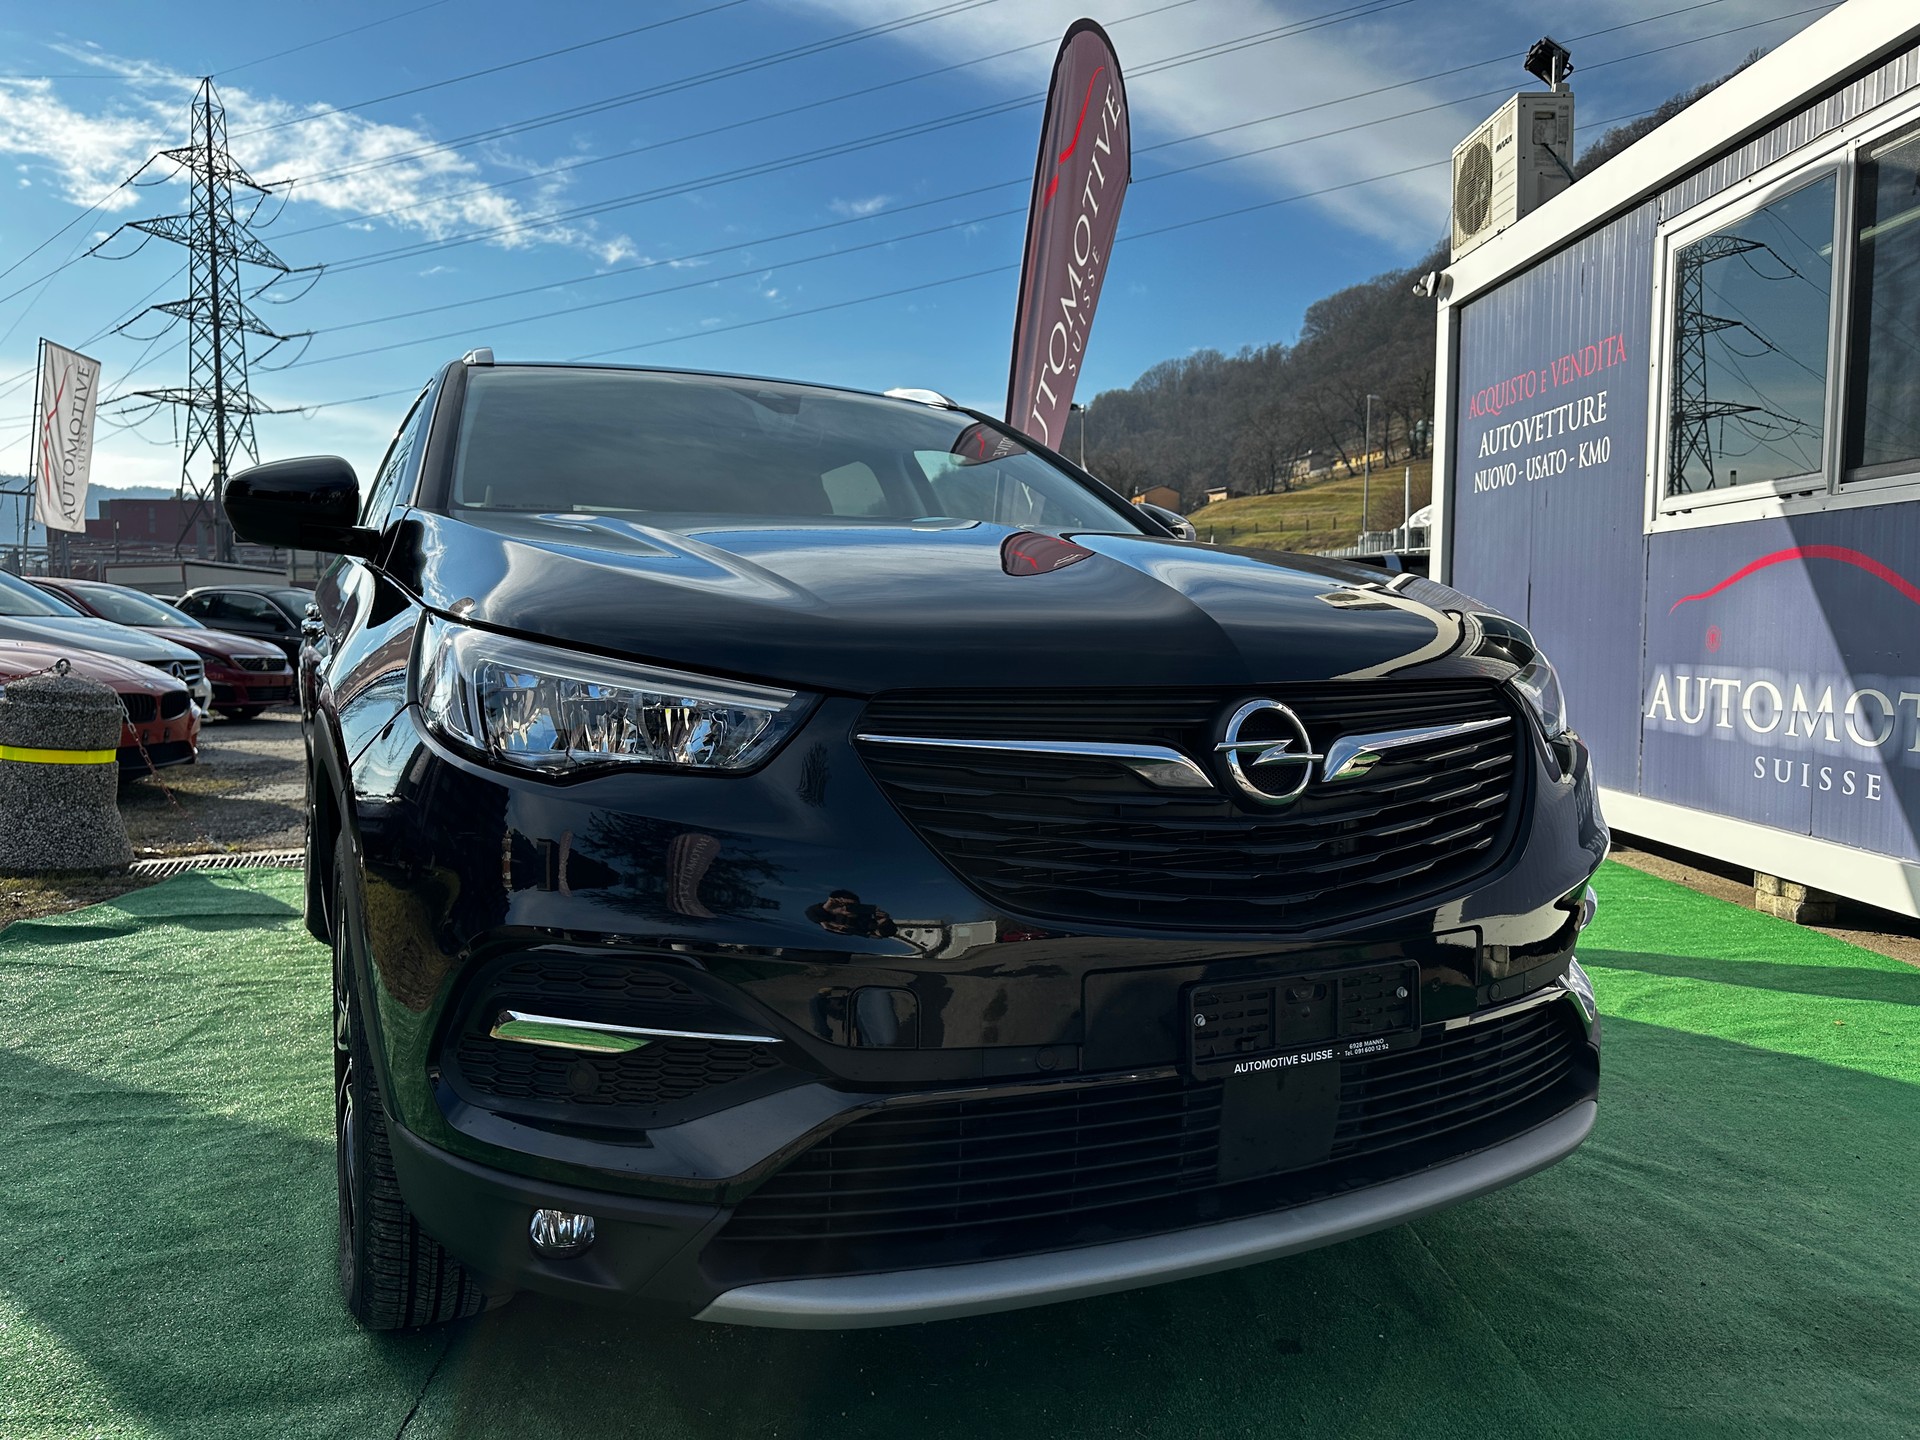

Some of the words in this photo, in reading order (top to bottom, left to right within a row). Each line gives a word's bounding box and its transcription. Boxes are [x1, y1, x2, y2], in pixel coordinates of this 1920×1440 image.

[1031, 83, 1121, 446] UTOMOTIVE
[1067, 245, 1100, 377] SUISSE
[1468, 370, 1536, 420] ACQUISTO
[1551, 332, 1627, 388] VENDITA
[63, 365, 90, 523] AUTOMOTIVE
[77, 423, 89, 471] SUISSE
[1478, 390, 1607, 458] AUTOVETTURE
[1474, 462, 1517, 493] NUOVO
[1526, 448, 1567, 481] USATO
[1754, 756, 1881, 800] SUISSE
[1234, 1055, 1298, 1074] AUTOMOTIVE
[1300, 1049, 1333, 1063] SUISSE
[1364, 1038, 1384, 1046] MANNO
